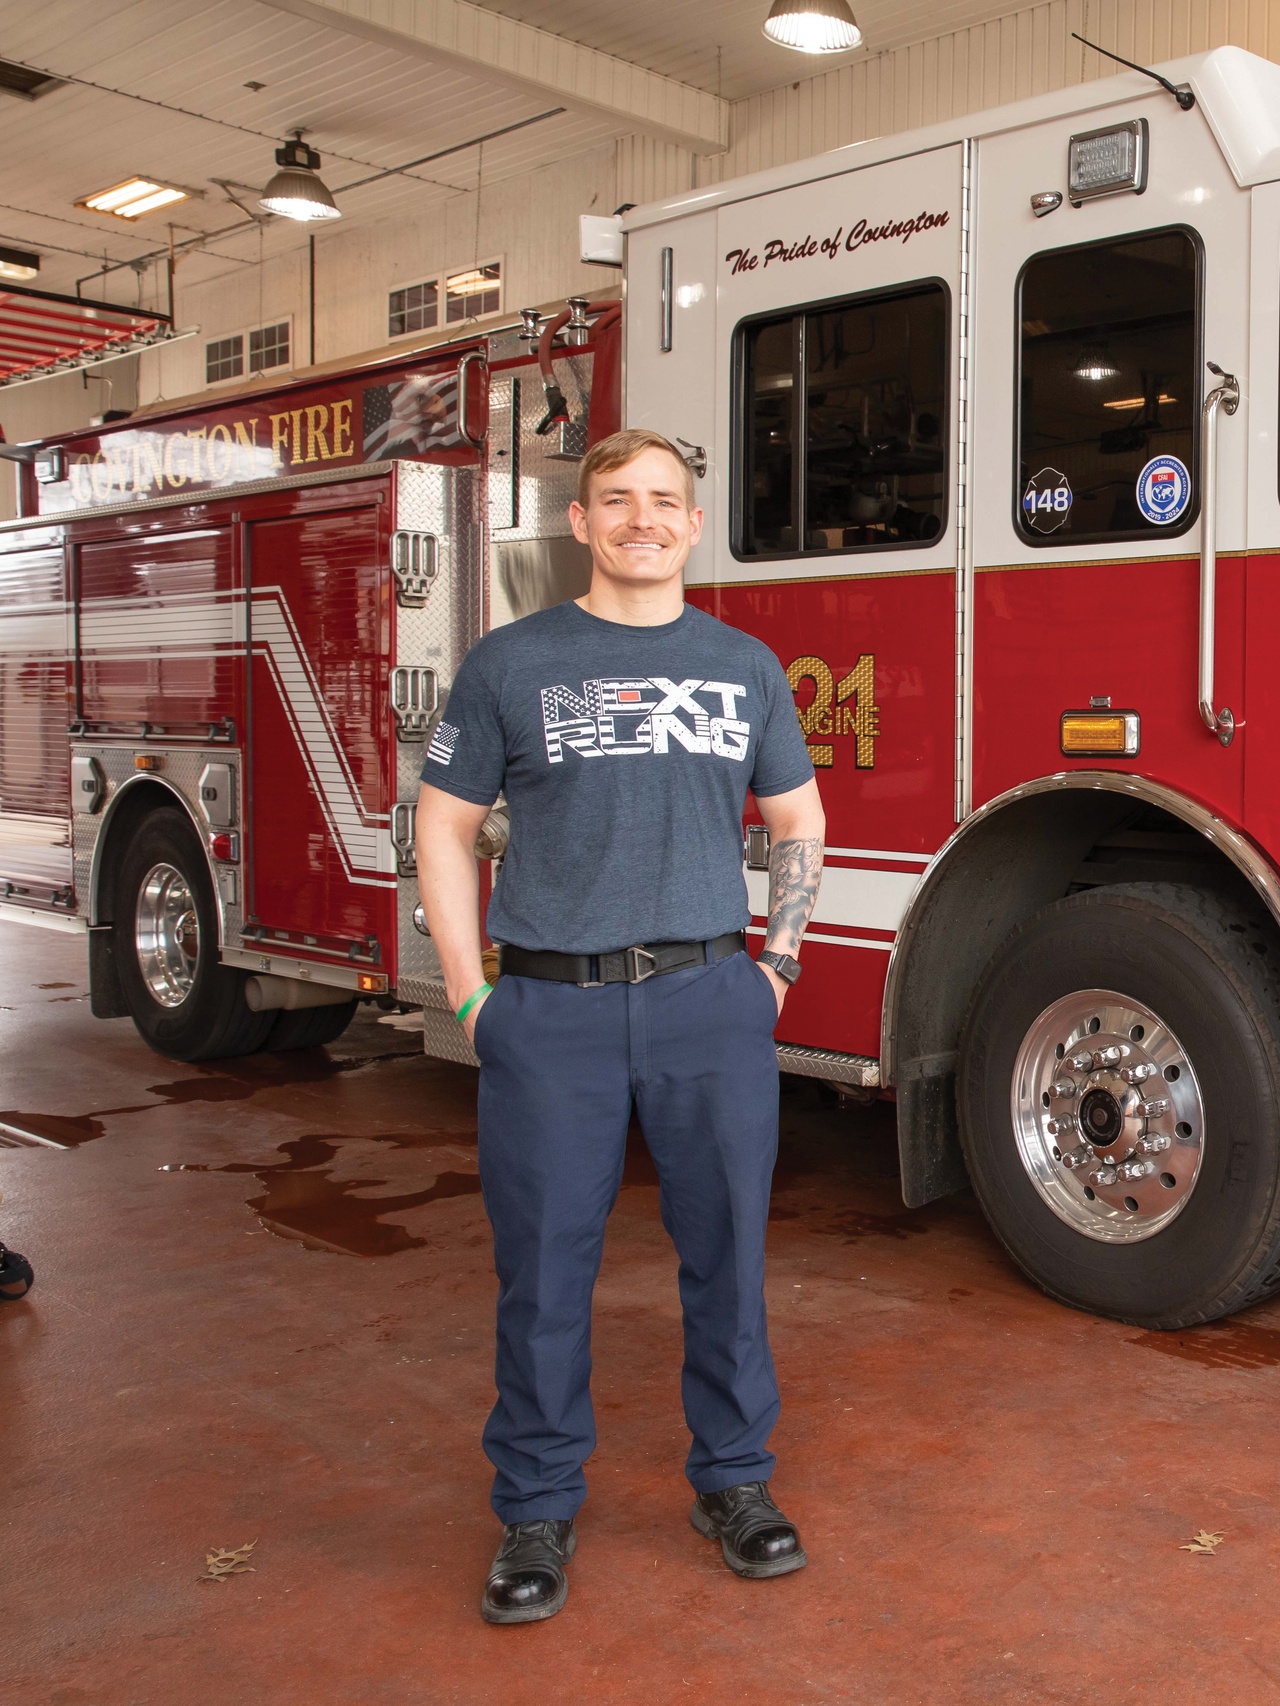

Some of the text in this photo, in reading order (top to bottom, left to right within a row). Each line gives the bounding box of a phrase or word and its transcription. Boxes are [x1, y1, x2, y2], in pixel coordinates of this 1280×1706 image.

[725, 210, 950, 275] The Pride of Covington
[70, 399, 355, 503] COVINGTON FIRE
[1025, 487, 1069, 514] 148
[540, 677, 747, 725] NEXT
[785, 653, 875, 770] 21
[796, 706, 880, 737] NGINE
[544, 713, 750, 764] RUNG
